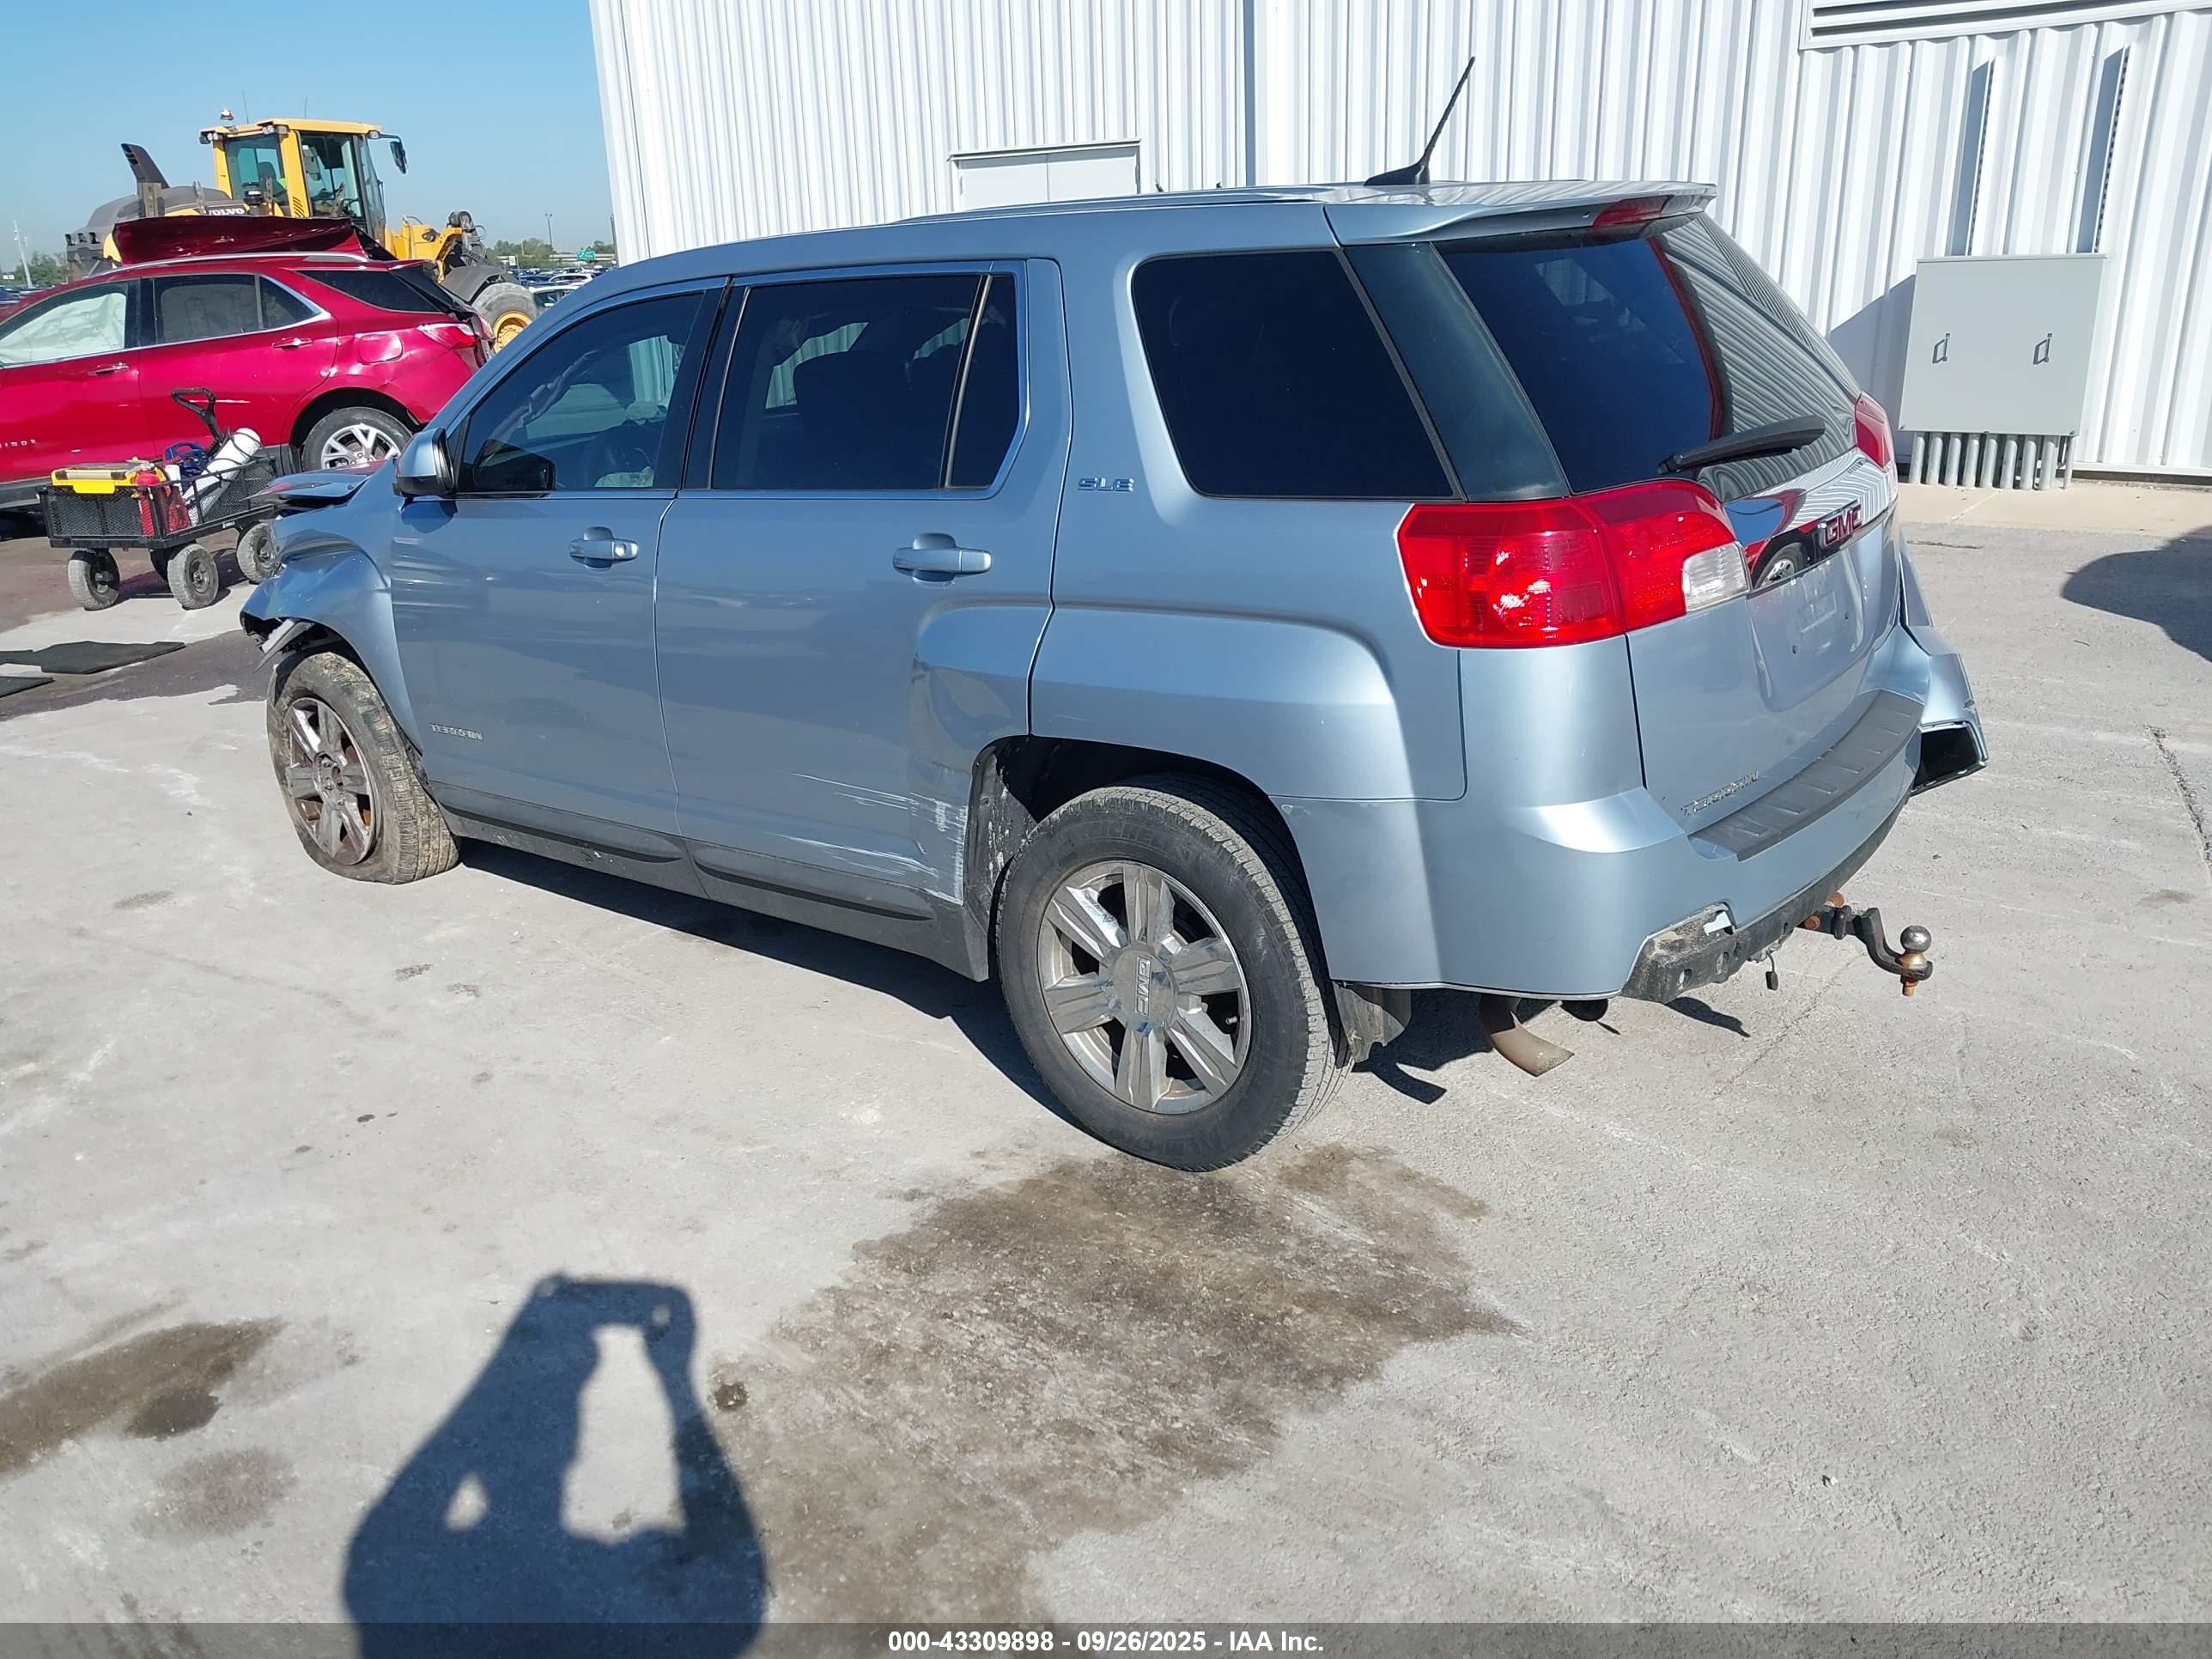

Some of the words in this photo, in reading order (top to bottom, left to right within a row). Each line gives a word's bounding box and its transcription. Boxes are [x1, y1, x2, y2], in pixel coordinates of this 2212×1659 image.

[1079, 477, 1134, 492] SLE
[1824, 503, 1863, 547] GMC
[1680, 770, 1759, 817] TERRAIN
[1135, 956, 1152, 1017] GMC
